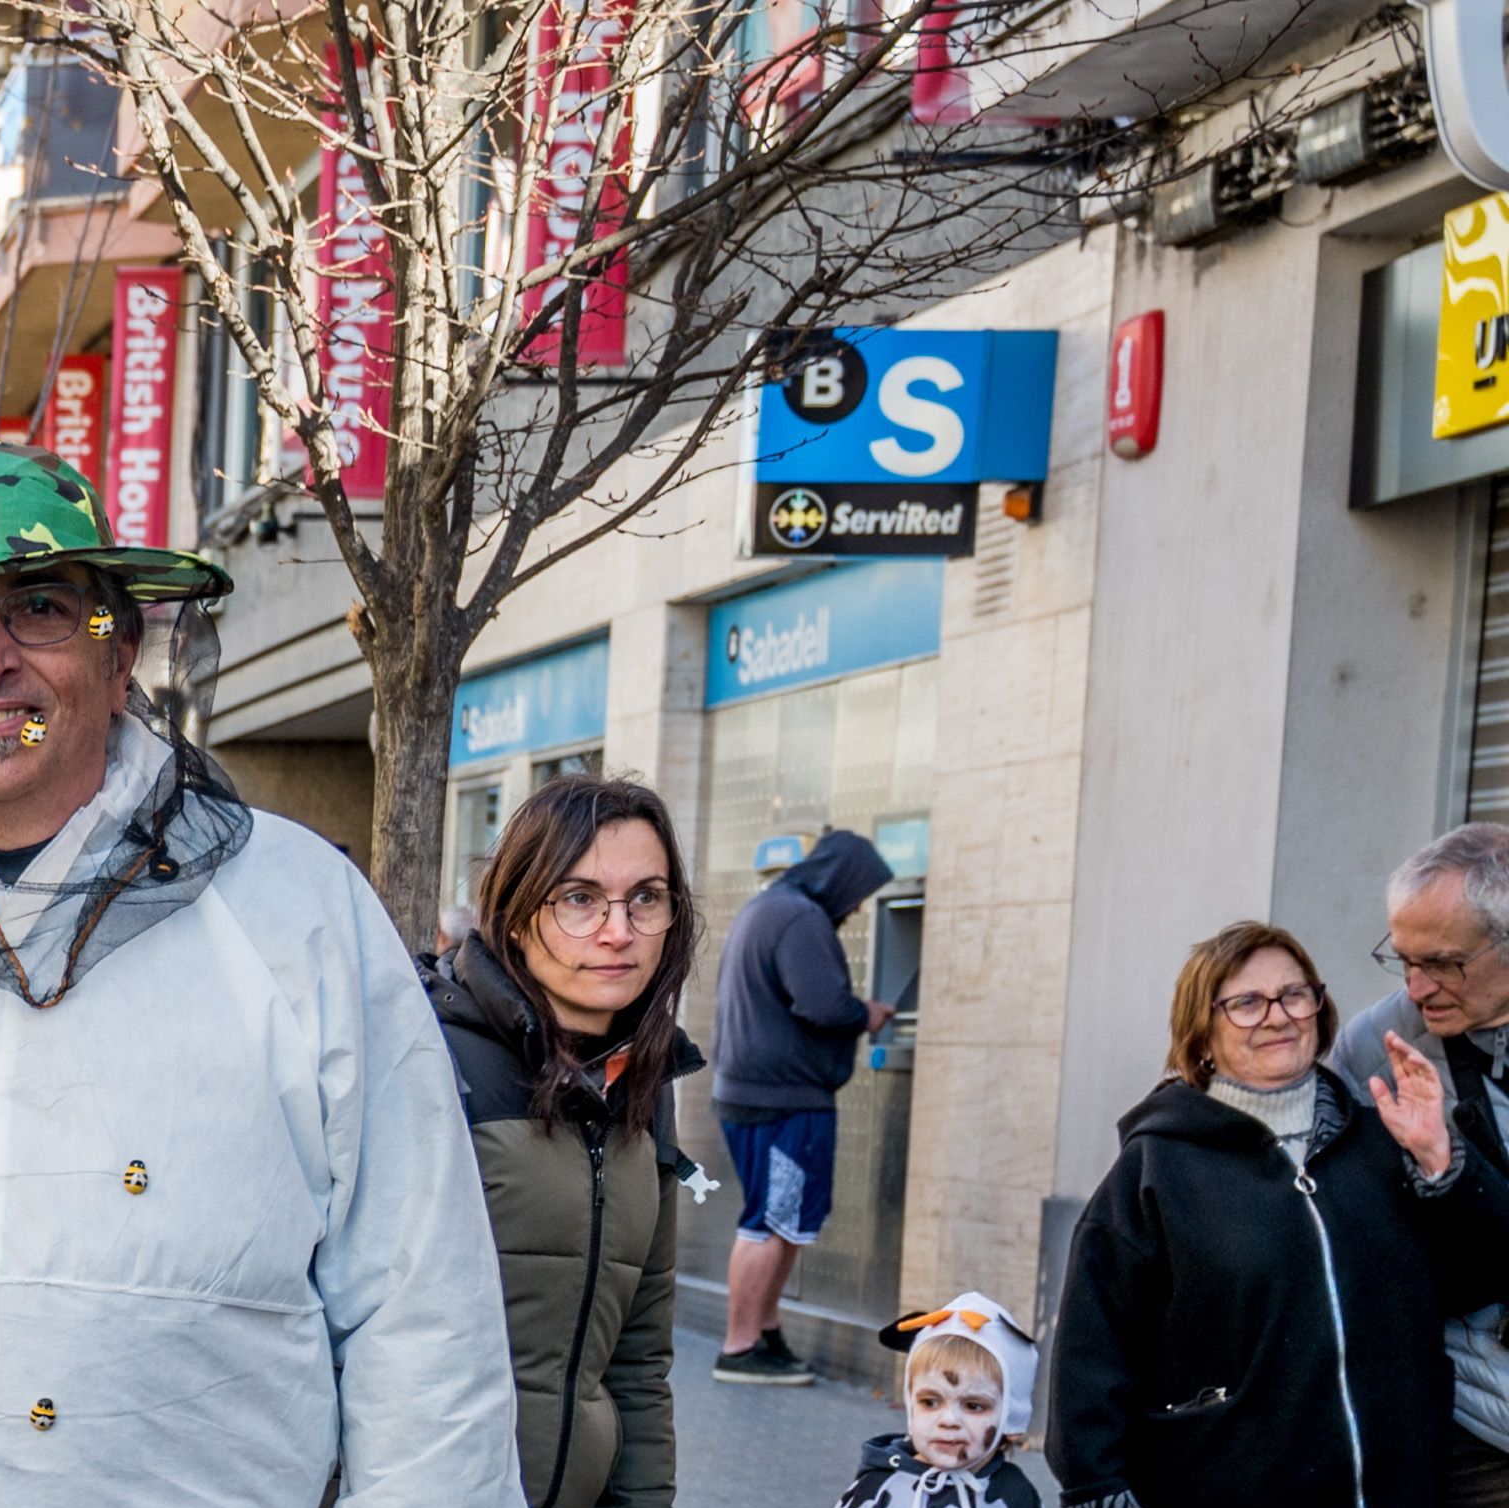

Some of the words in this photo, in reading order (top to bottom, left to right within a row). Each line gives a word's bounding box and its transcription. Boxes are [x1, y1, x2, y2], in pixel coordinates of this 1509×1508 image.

[122, 284, 169, 435] British
[802, 356, 845, 408] B
[869, 355, 965, 478] S
[830, 502, 964, 535] ServiRed
[737, 606, 830, 687] Sabadell
